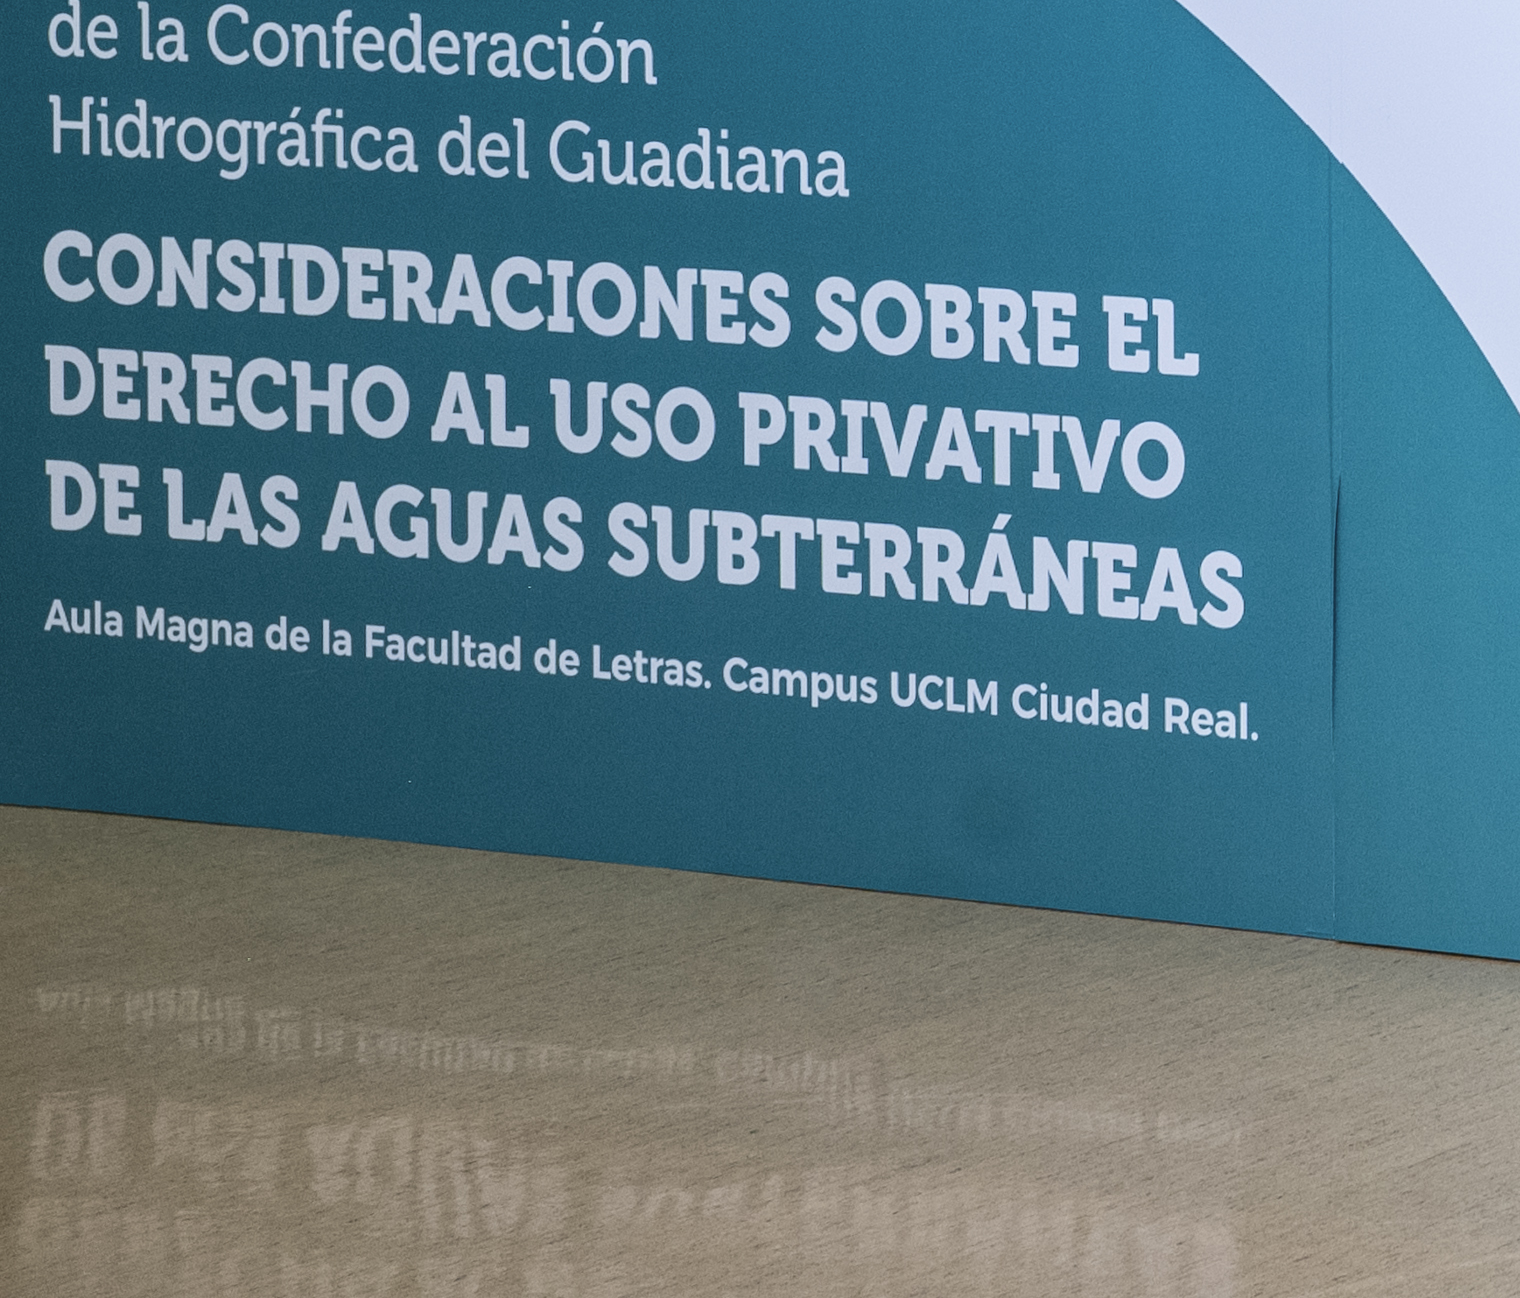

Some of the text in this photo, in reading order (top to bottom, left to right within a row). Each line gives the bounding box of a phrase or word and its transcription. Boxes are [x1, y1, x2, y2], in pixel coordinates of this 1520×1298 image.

[138, 1, 188, 62] la
[207, 4, 657, 85] Confederación
[49, 95, 849, 197] Hidrográfica del Guadiana
[43, 230, 1199, 376] CONSIDERACIONES SOBRE EL
[45, 345, 1185, 499] DERECHO AL USO PRIVATIVO
[45, 460, 1244, 629] DE LAS AGUAS SUBTERRÁNEAS
[44, 599, 1258, 741] Aula Magna de la Facultad de Letras. Campus UCLM Ciudad Real.
